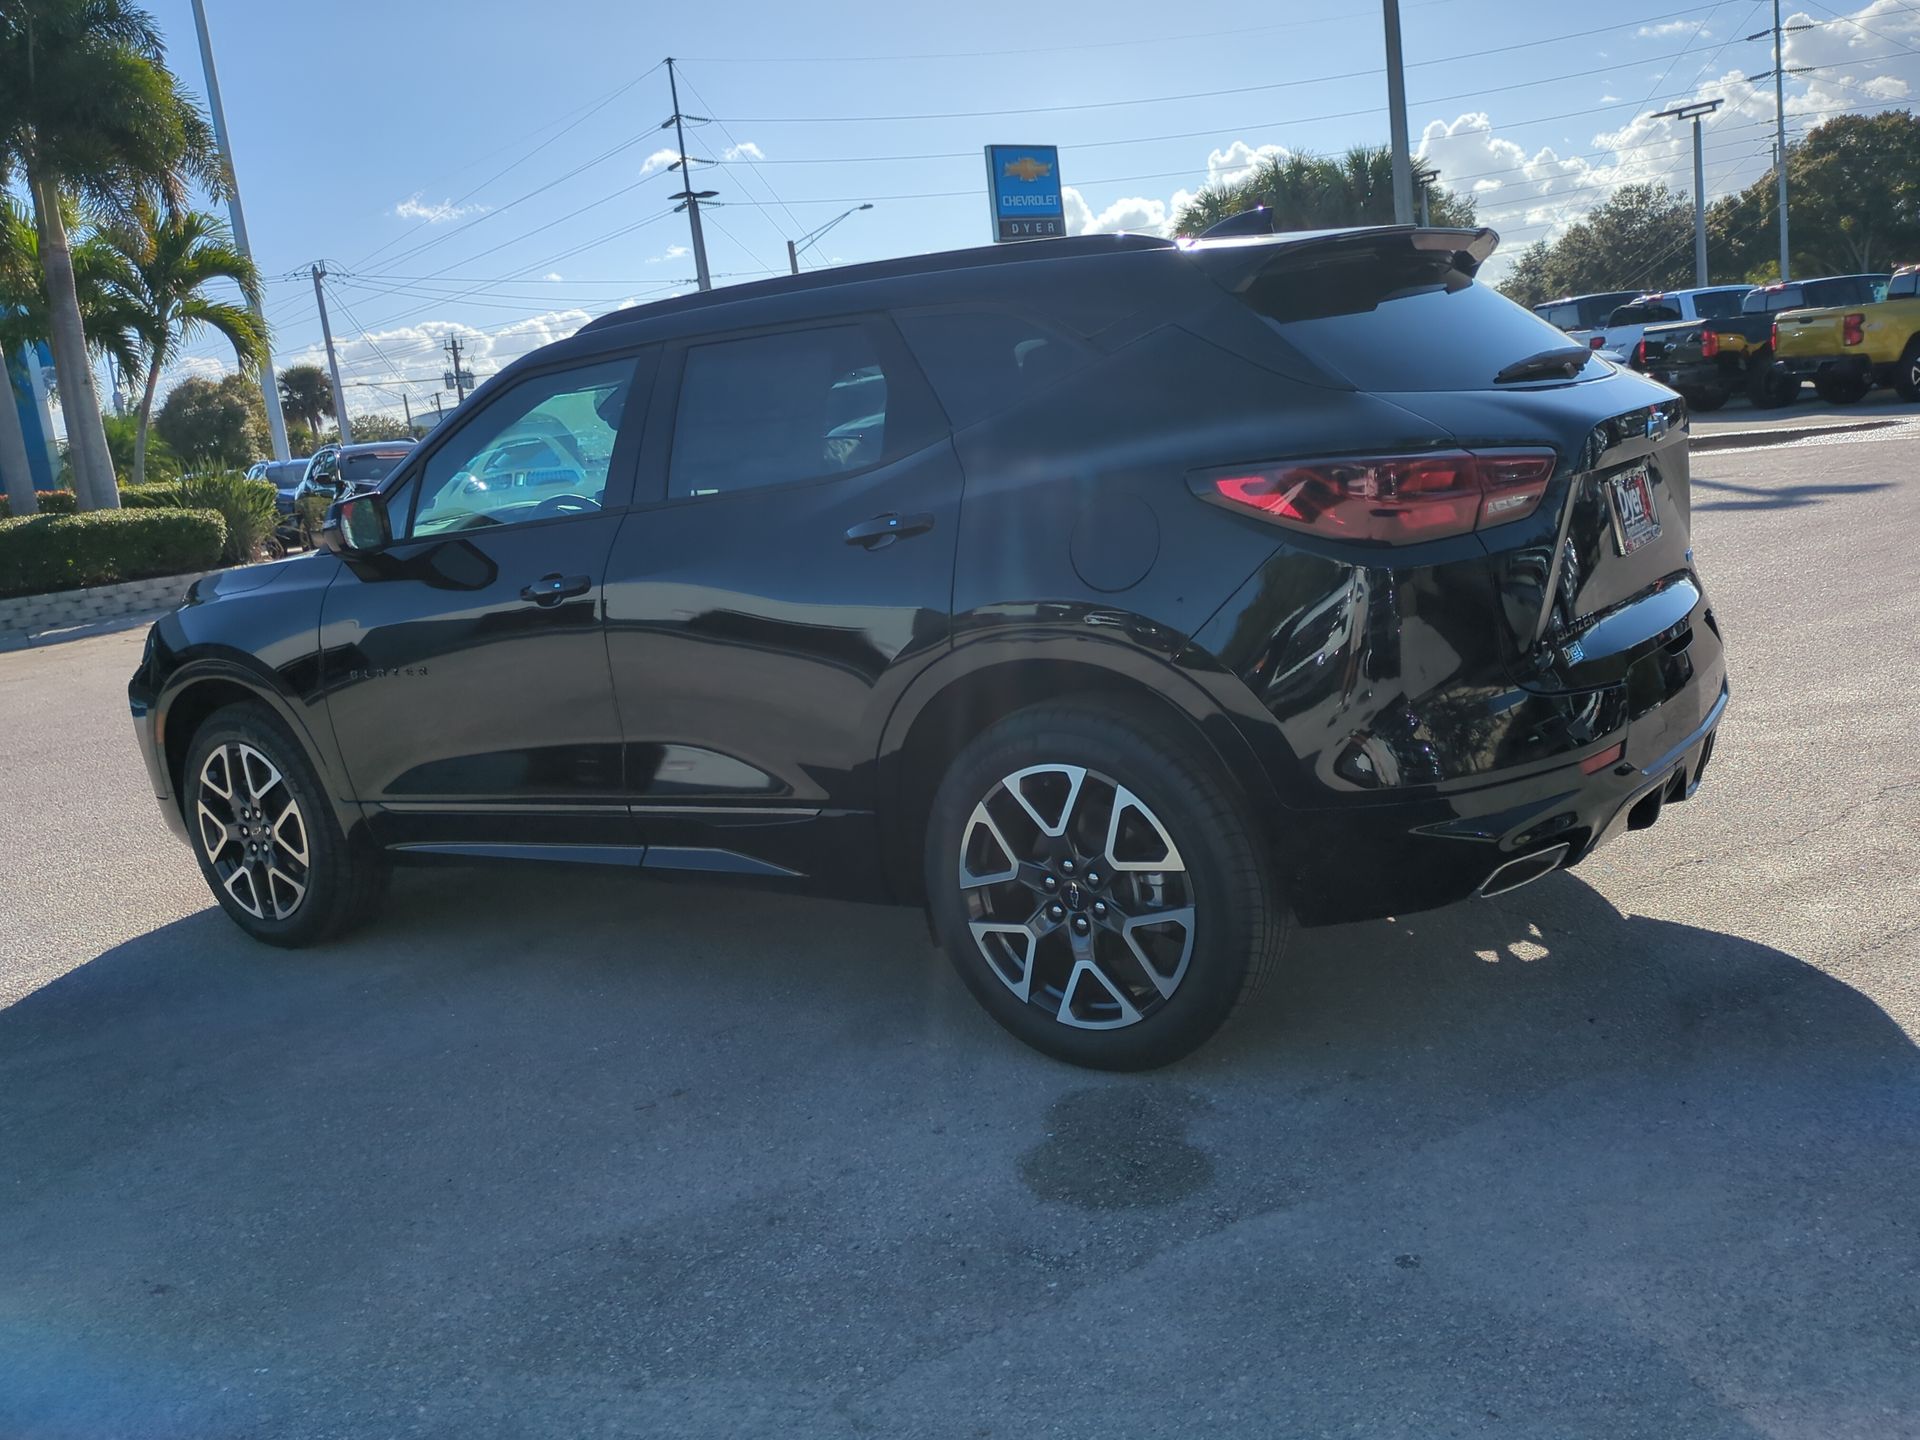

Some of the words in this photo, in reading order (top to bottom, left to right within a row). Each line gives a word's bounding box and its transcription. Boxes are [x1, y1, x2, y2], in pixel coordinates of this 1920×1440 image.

[1002, 194, 1057, 206] CHEVROLET
[1011, 222, 1054, 234] DYER
[1616, 485, 1643, 524] Dyer
